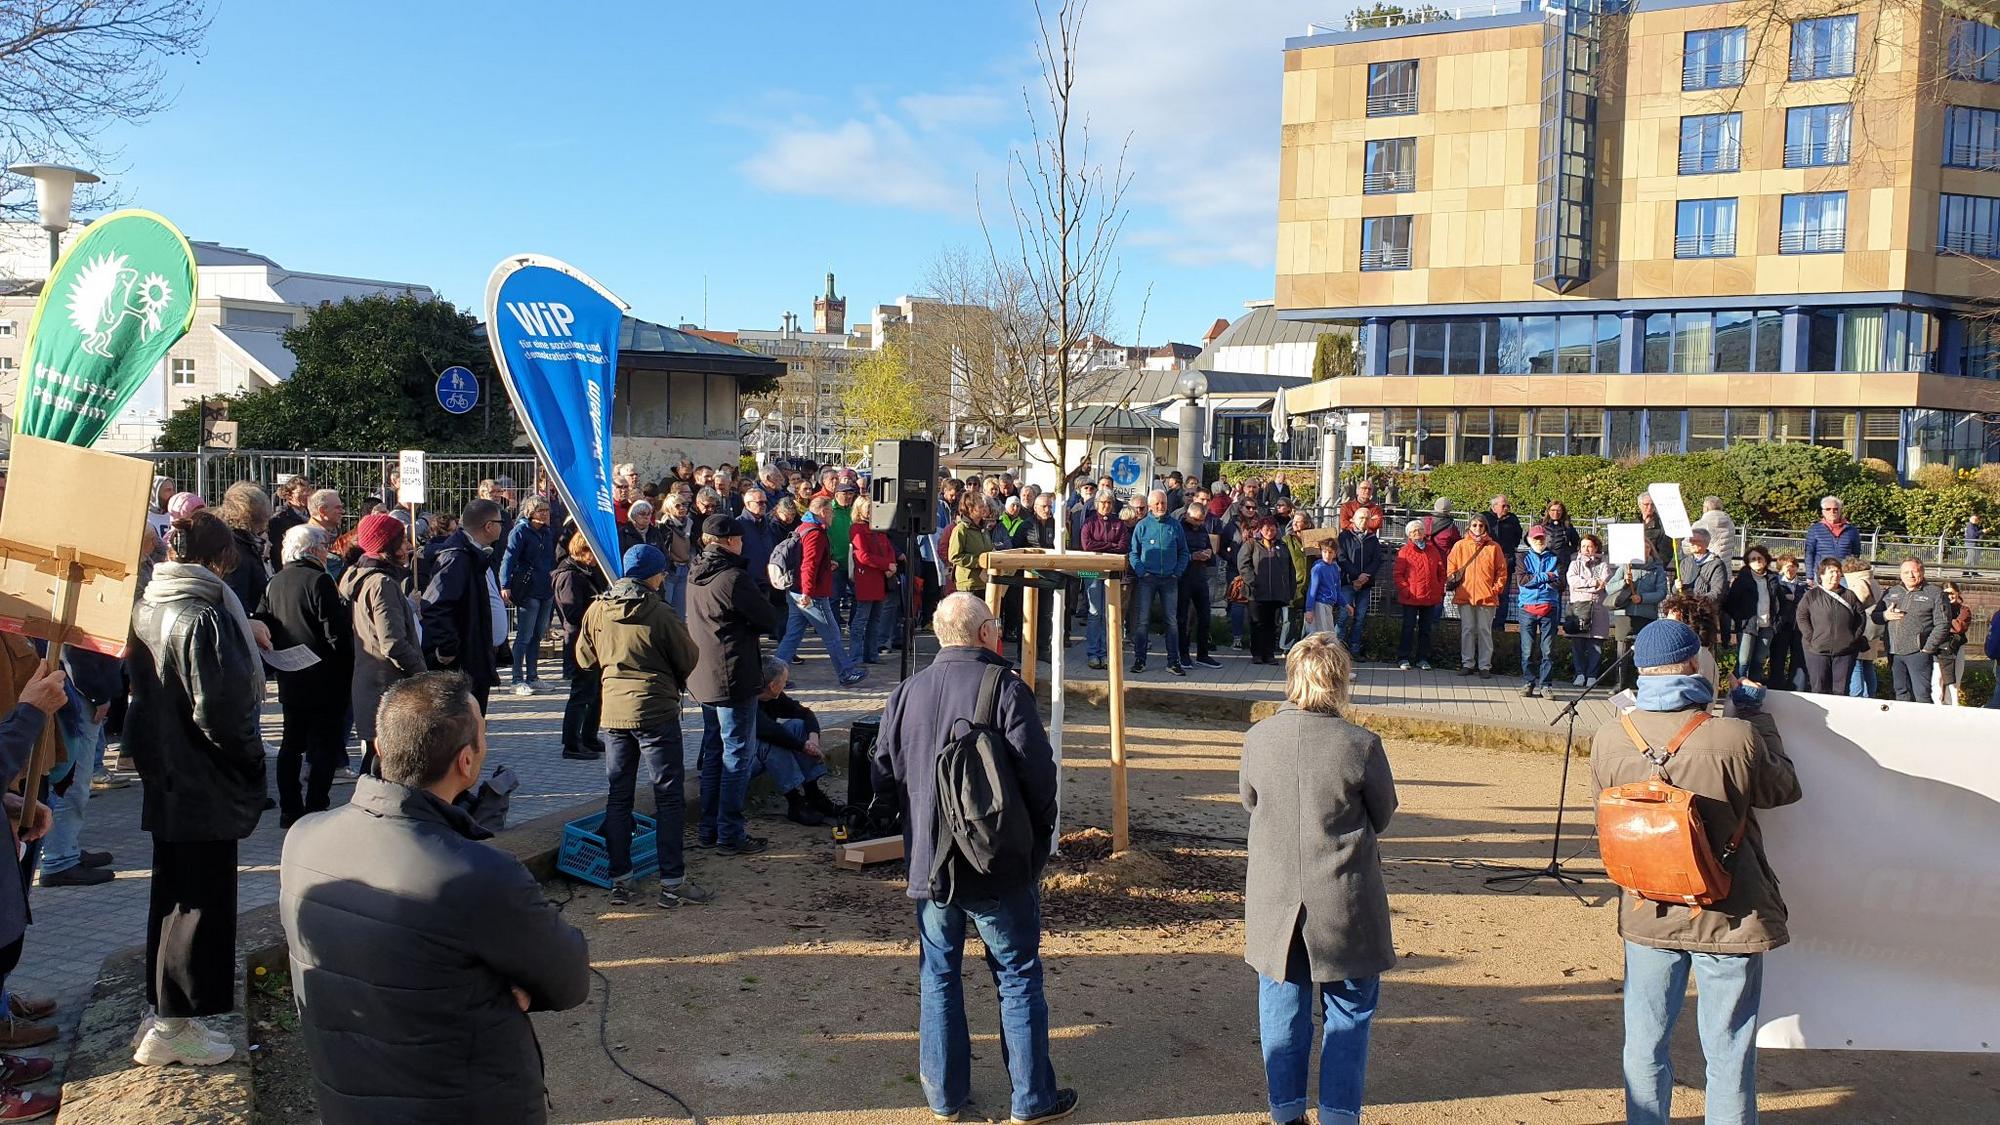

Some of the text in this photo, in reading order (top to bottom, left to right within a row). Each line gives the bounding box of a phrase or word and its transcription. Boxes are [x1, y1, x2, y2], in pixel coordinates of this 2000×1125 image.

[506, 302, 575, 336] WiP
[585, 342, 602, 352] und
[1113, 487, 1136, 496] ZONE
